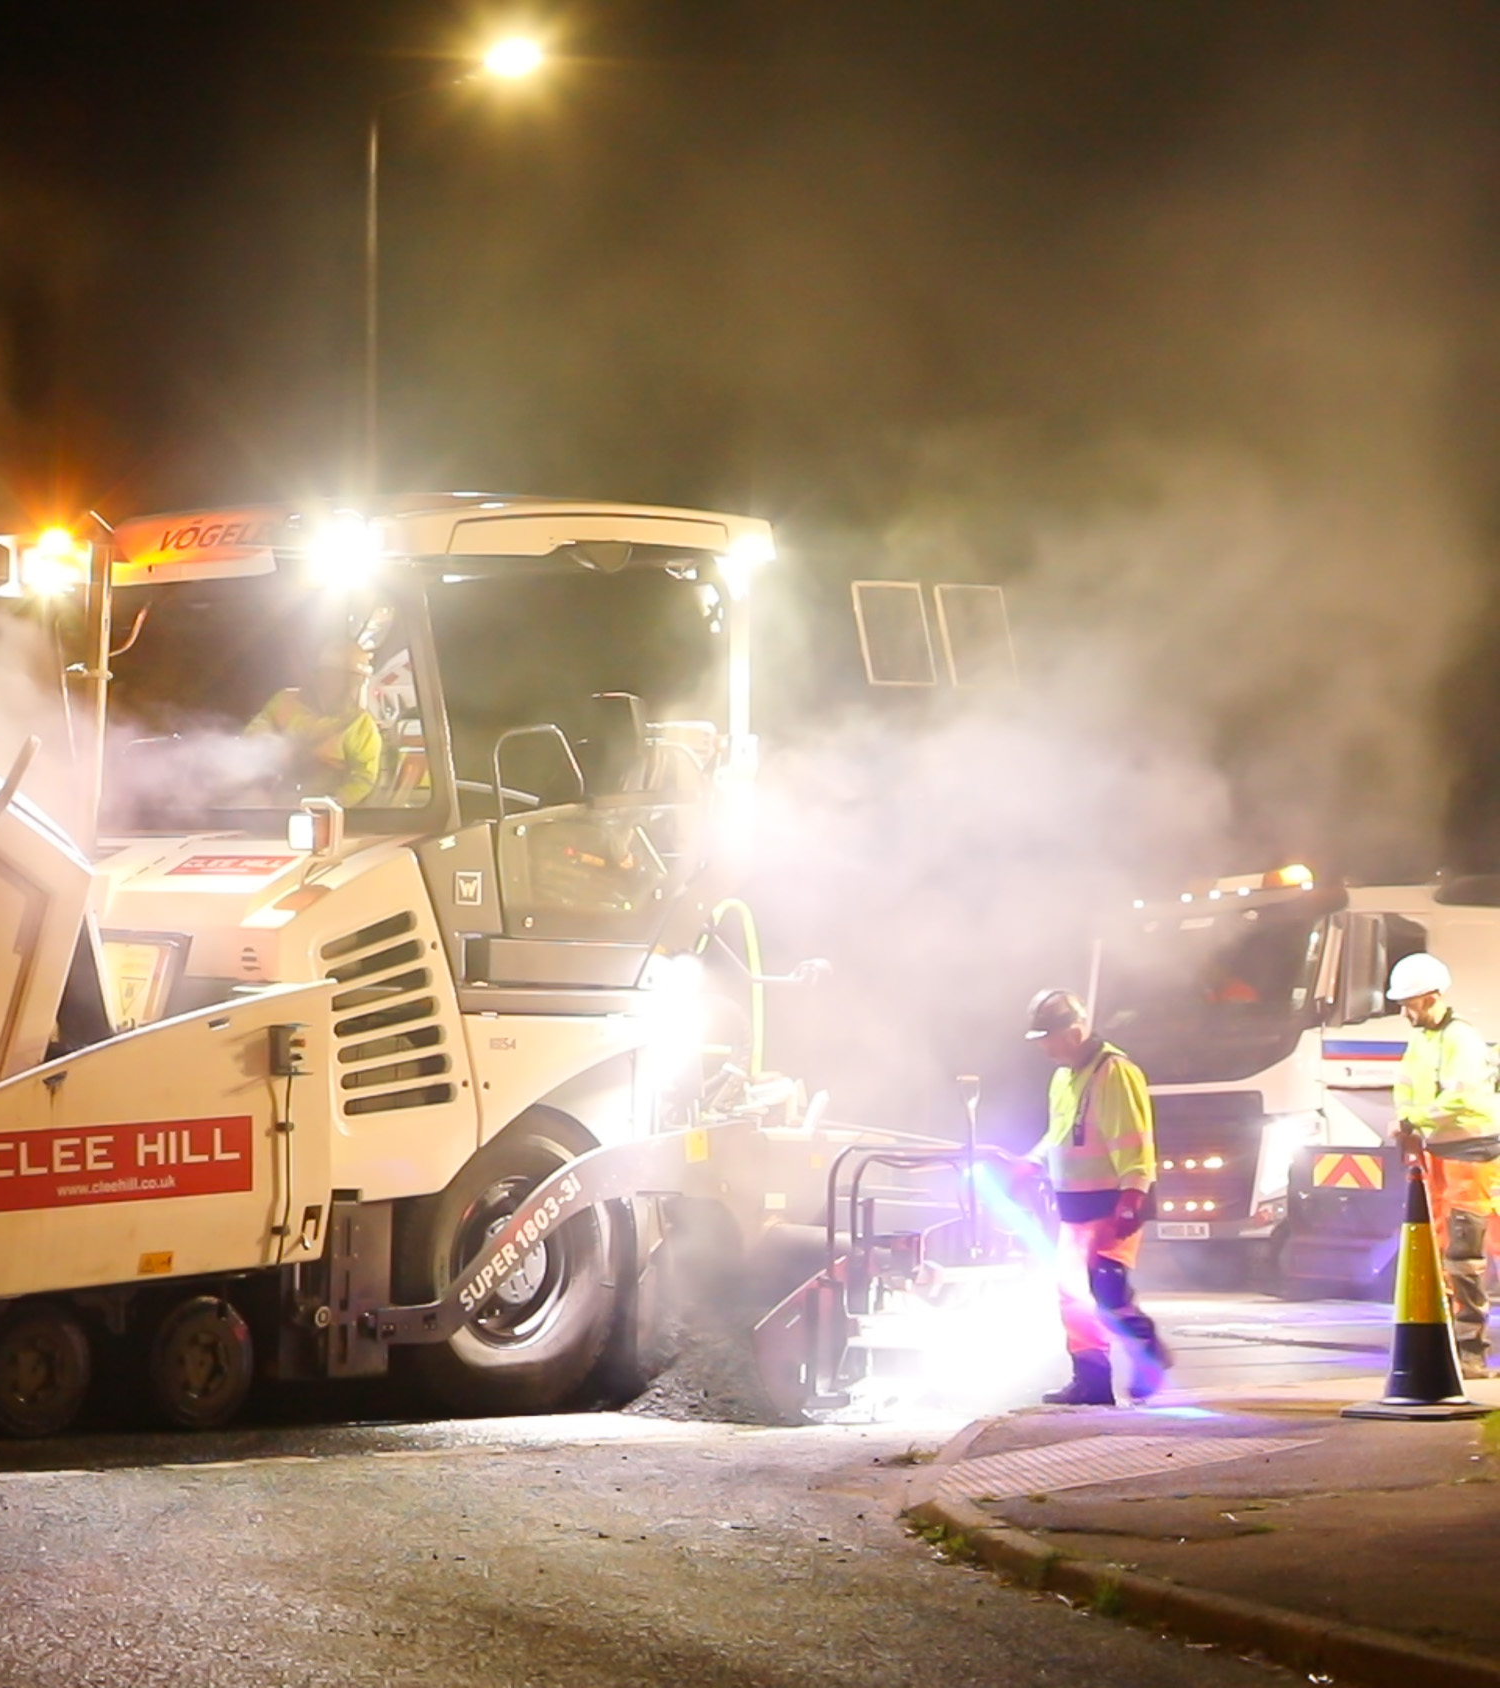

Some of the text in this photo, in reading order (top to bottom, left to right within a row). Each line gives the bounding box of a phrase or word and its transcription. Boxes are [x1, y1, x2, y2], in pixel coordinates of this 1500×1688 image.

[136, 1127, 241, 1167] HILL
[55, 1174, 177, 1197] www.cleehill.co.uk
[459, 1242, 520, 1312] SUPER
